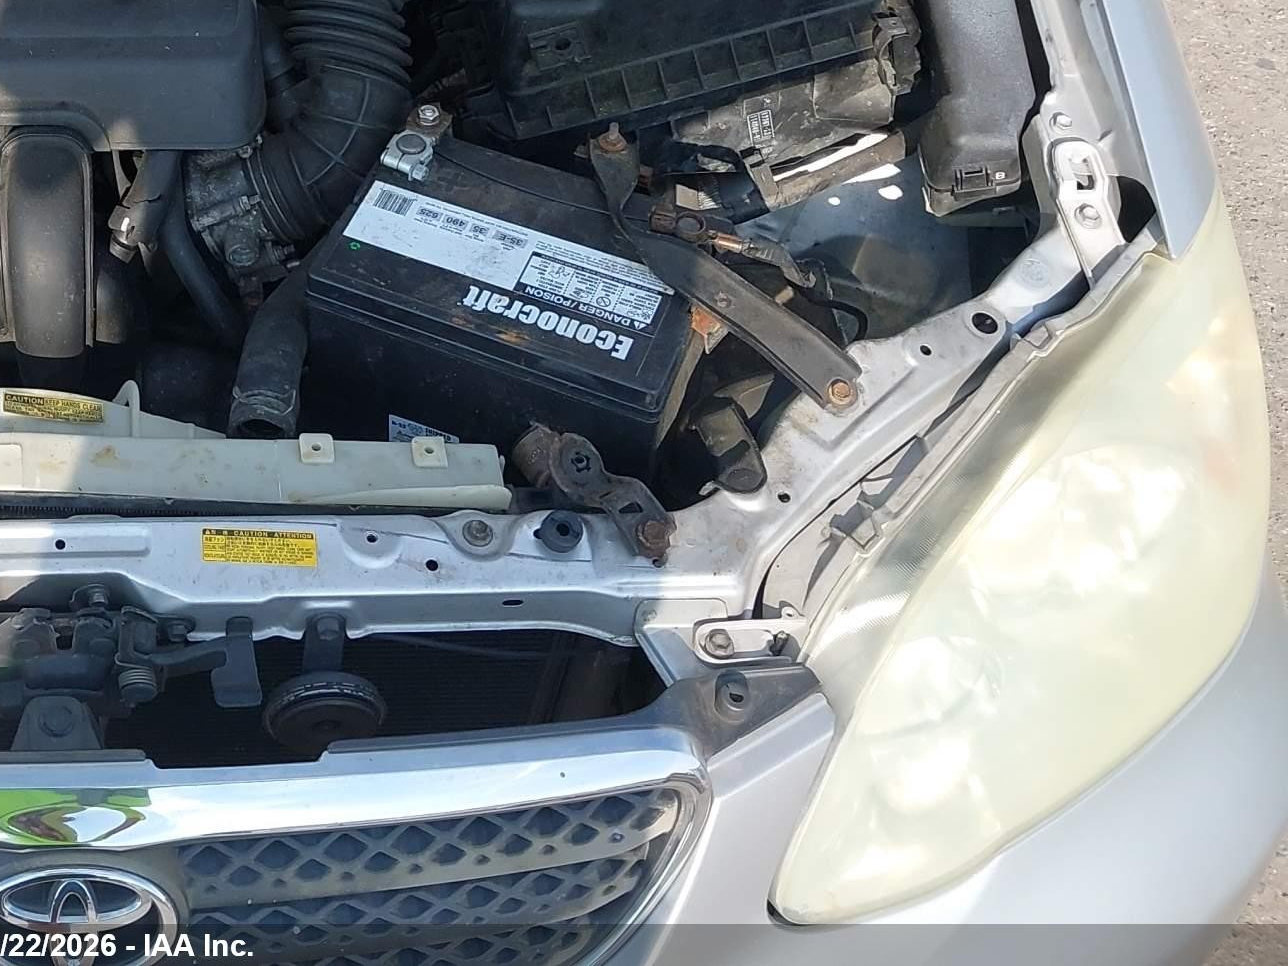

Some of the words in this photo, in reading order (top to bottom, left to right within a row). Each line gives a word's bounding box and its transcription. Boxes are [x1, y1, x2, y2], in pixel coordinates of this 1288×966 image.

[446, 217, 466, 227] 490
[473, 225, 488, 234] 35
[499, 233, 524, 246] 35-E
[578, 302, 631, 326] DANGER
[465, 286, 635, 360] Econocraft
[5, 395, 44, 405] CAUTION
[233, 530, 268, 538] CAUTION
[274, 531, 312, 539] ATTENTION
